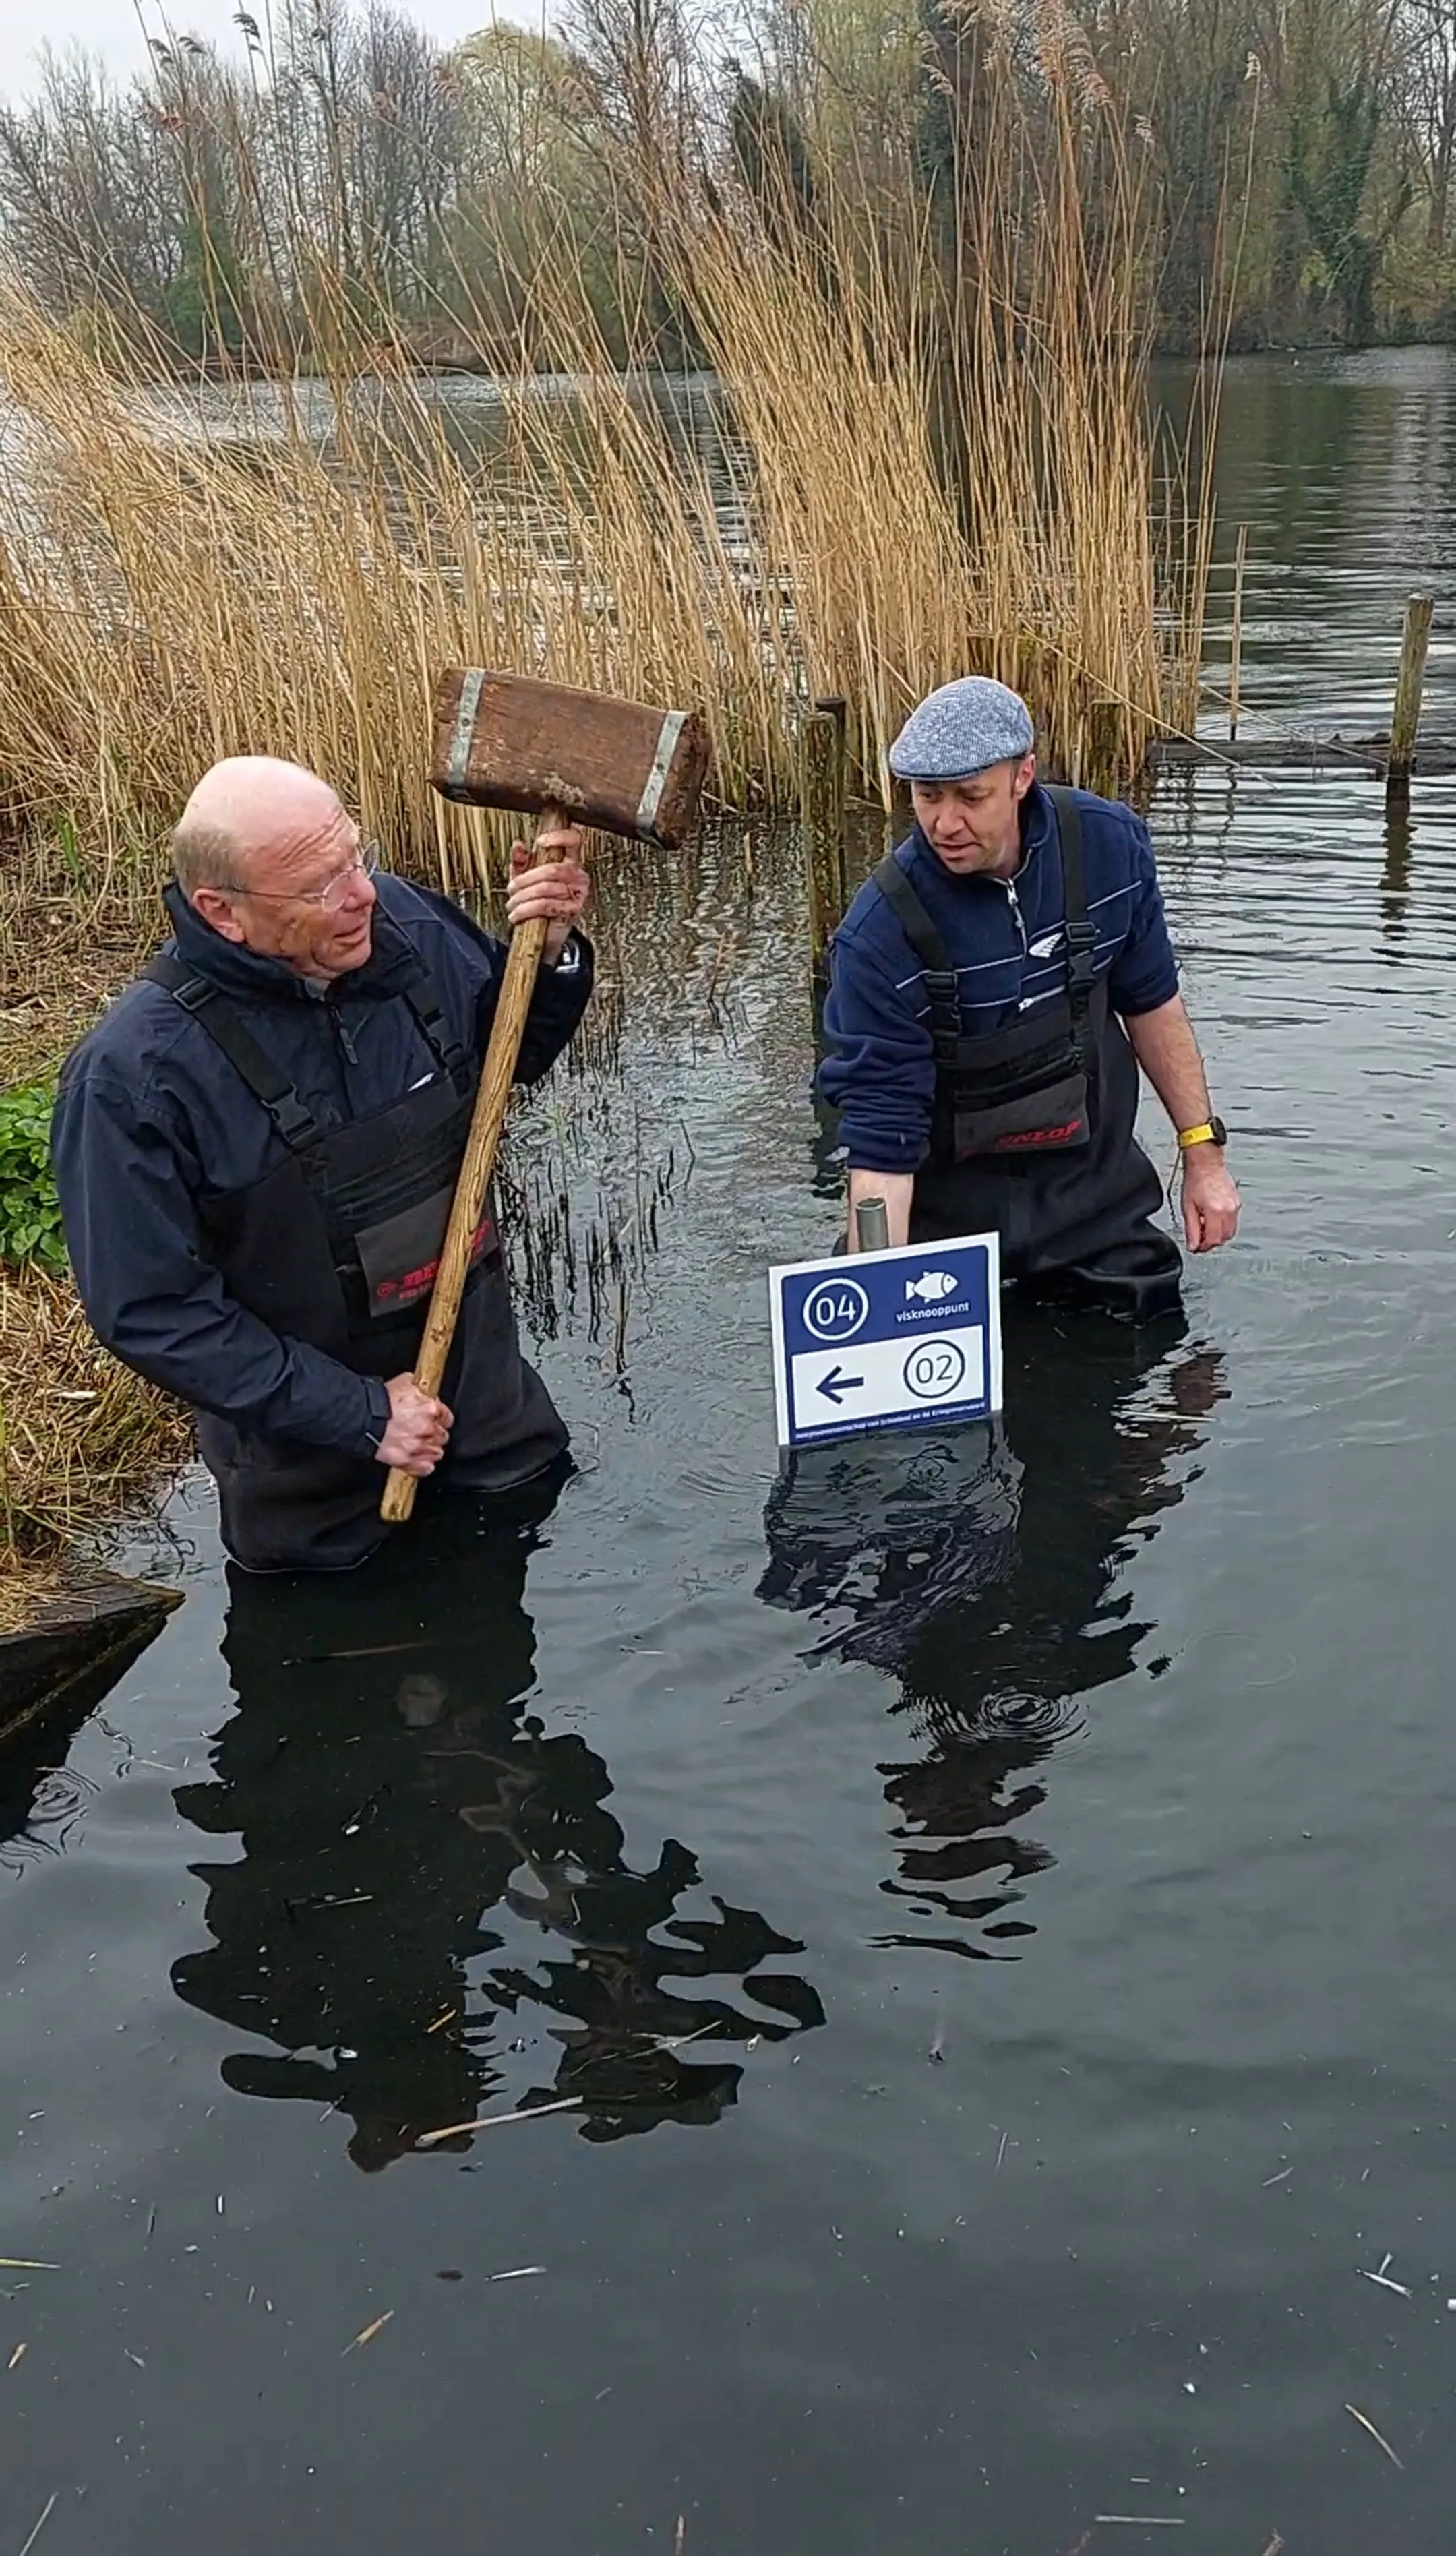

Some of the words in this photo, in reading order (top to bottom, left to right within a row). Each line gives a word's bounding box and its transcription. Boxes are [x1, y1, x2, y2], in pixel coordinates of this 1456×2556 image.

[816, 1294, 856, 1325] 04
[896, 1302, 970, 1322] visknooppunt
[915, 1354, 953, 1384] 02
